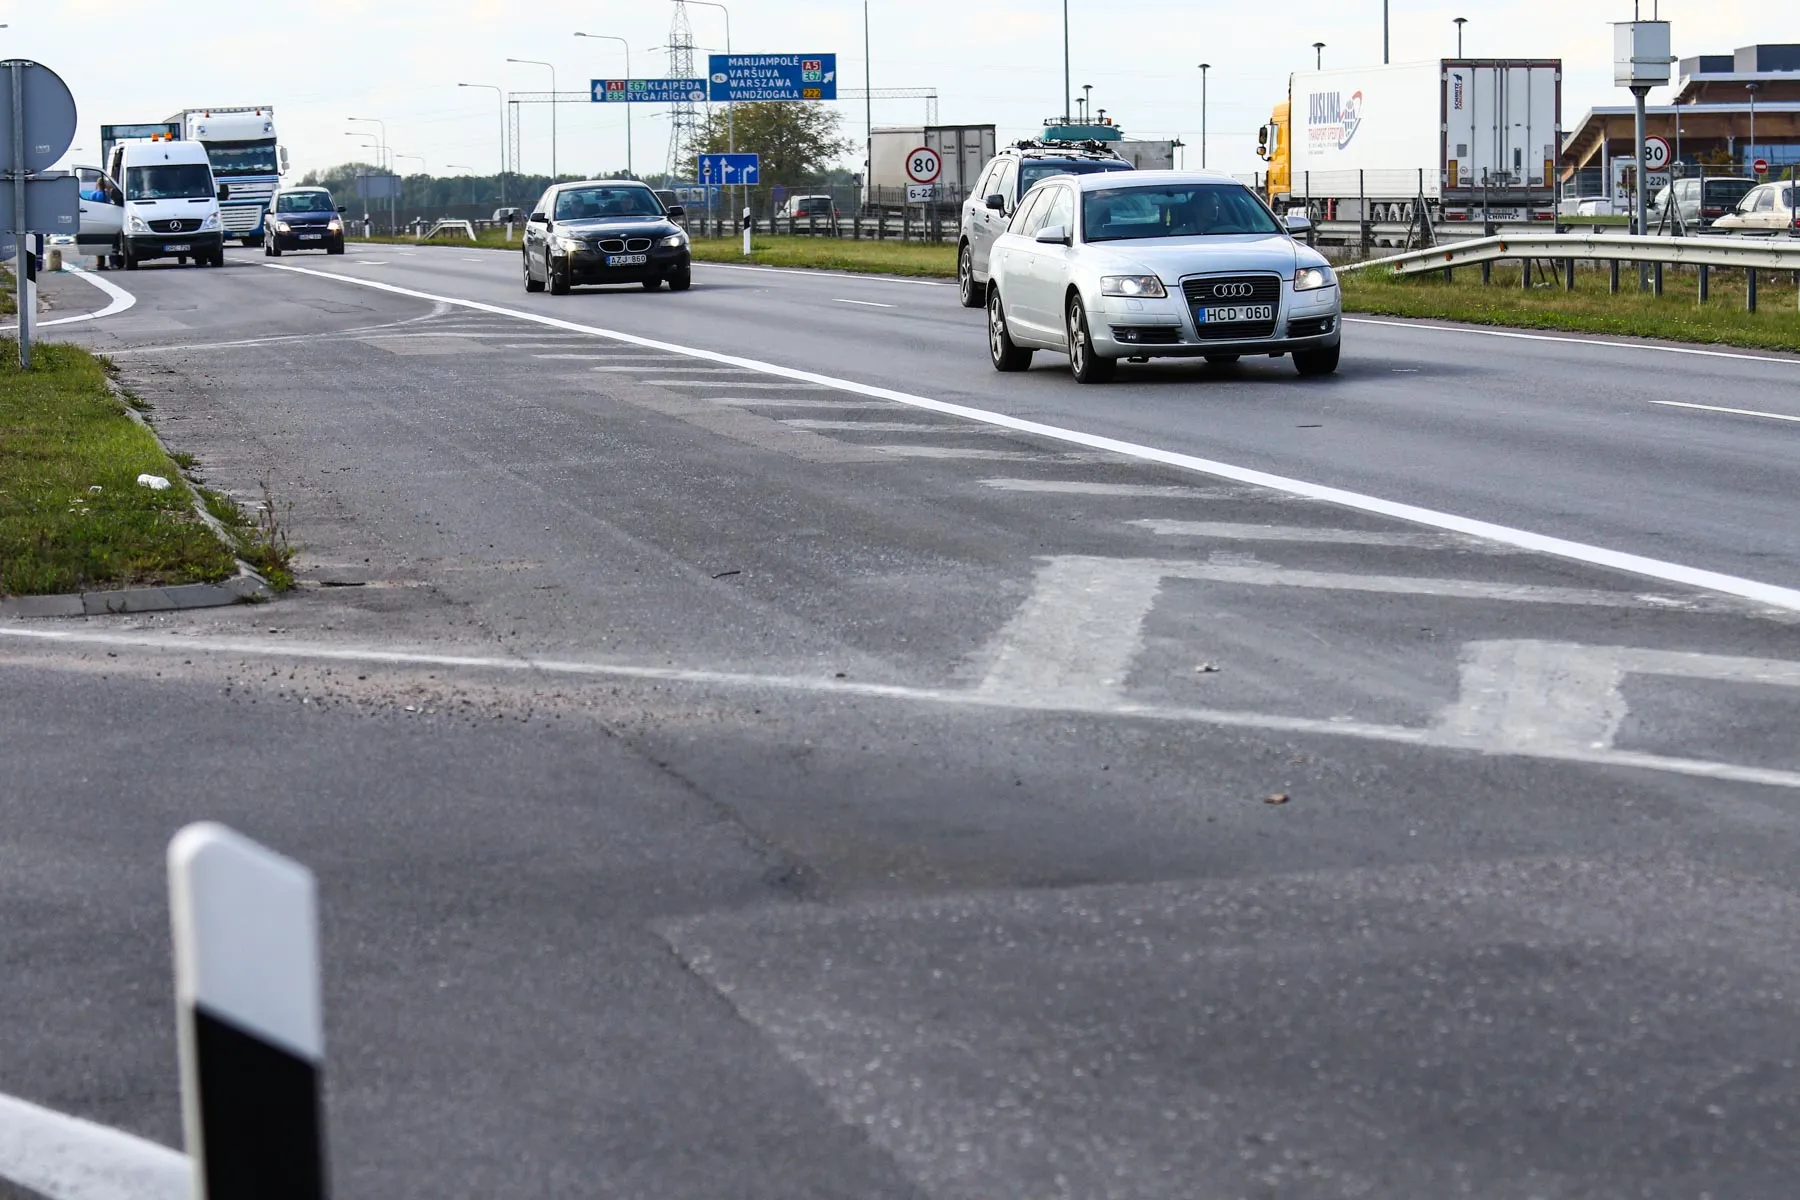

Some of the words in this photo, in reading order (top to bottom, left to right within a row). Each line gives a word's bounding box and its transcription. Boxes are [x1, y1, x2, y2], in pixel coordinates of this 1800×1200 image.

[728, 56, 799, 66] MARIJAMPOLĖ
[805, 62, 819, 70] A5
[729, 67, 779, 78] VARŠUVA
[803, 71, 820, 80] E67
[610, 82, 621, 90] A1
[628, 82, 645, 90] E67
[647, 80, 701, 90] KLAIPĖDA
[729, 79, 792, 87] WARSZAWA
[607, 92, 624, 100] E85
[729, 88, 799, 99] VANDŽIOGALA
[803, 89, 820, 98] 222
[1309, 91, 1341, 124] JUSLINA
[1645, 147, 1663, 160] 80
[914, 158, 935, 173] 80
[1645, 176, 1668, 186] -22h
[612, 256, 627, 264] AZJ
[1207, 308, 1237, 321] HCD
[1246, 306, 1270, 319] 060
